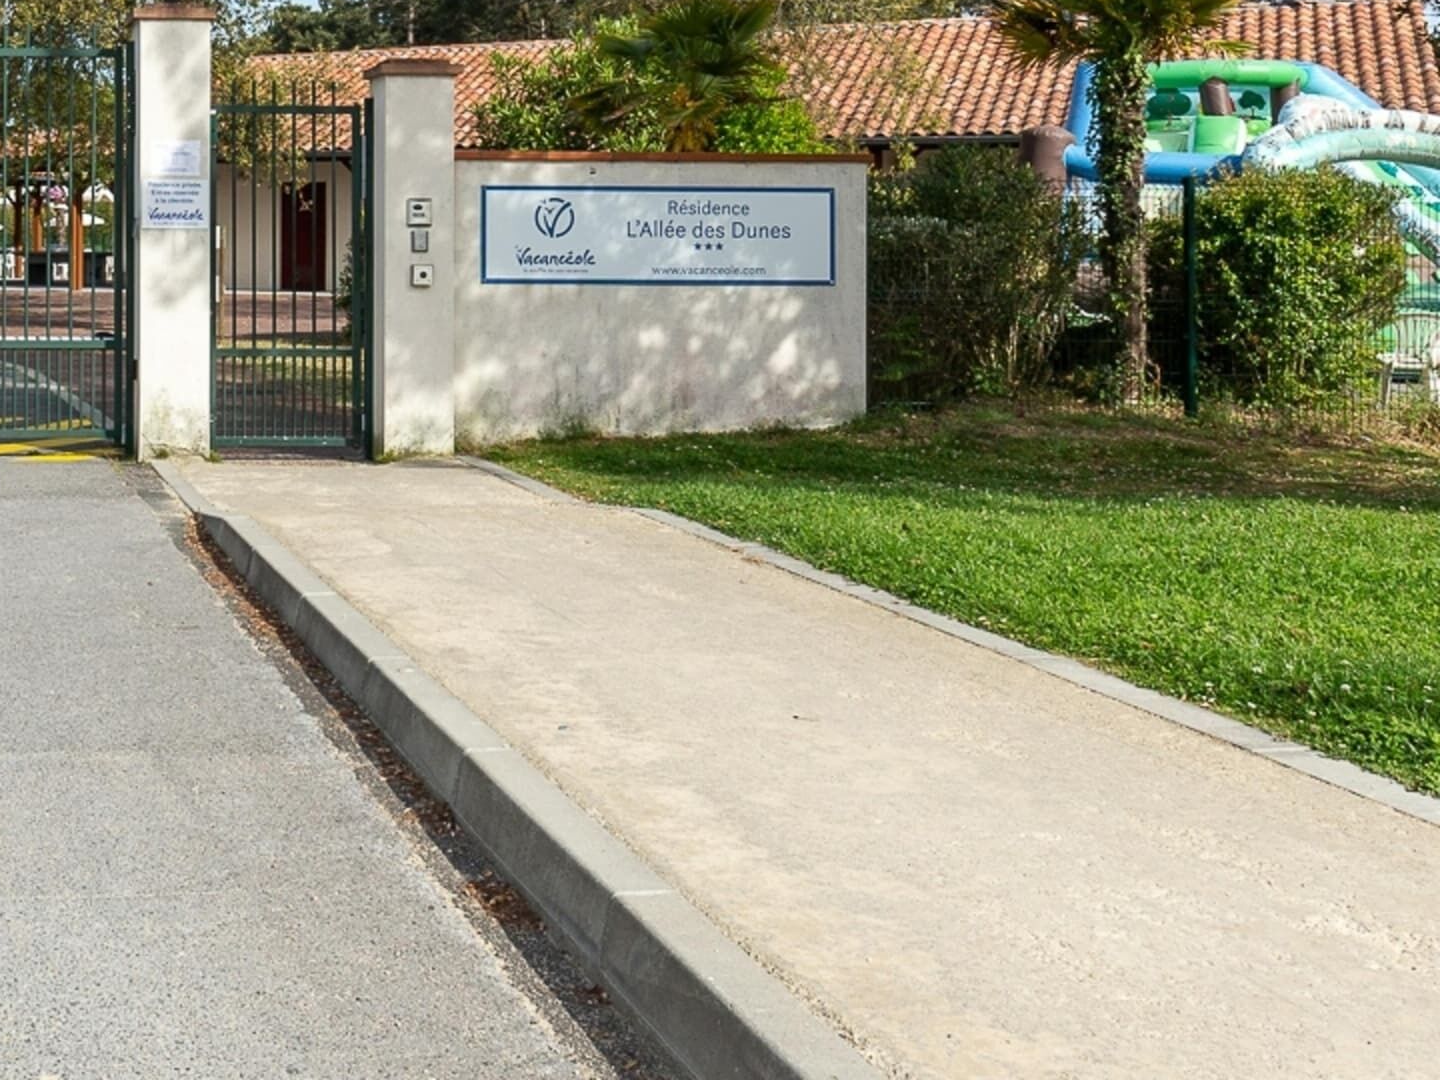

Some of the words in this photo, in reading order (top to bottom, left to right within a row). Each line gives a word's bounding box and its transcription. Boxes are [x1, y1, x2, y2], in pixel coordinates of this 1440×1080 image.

[667, 199, 750, 216] Résidence
[626, 219, 687, 239] L'Allée
[691, 220, 726, 239] des
[731, 221, 792, 239] Dunes
[651, 265, 766, 276] www.vacanceole.com
